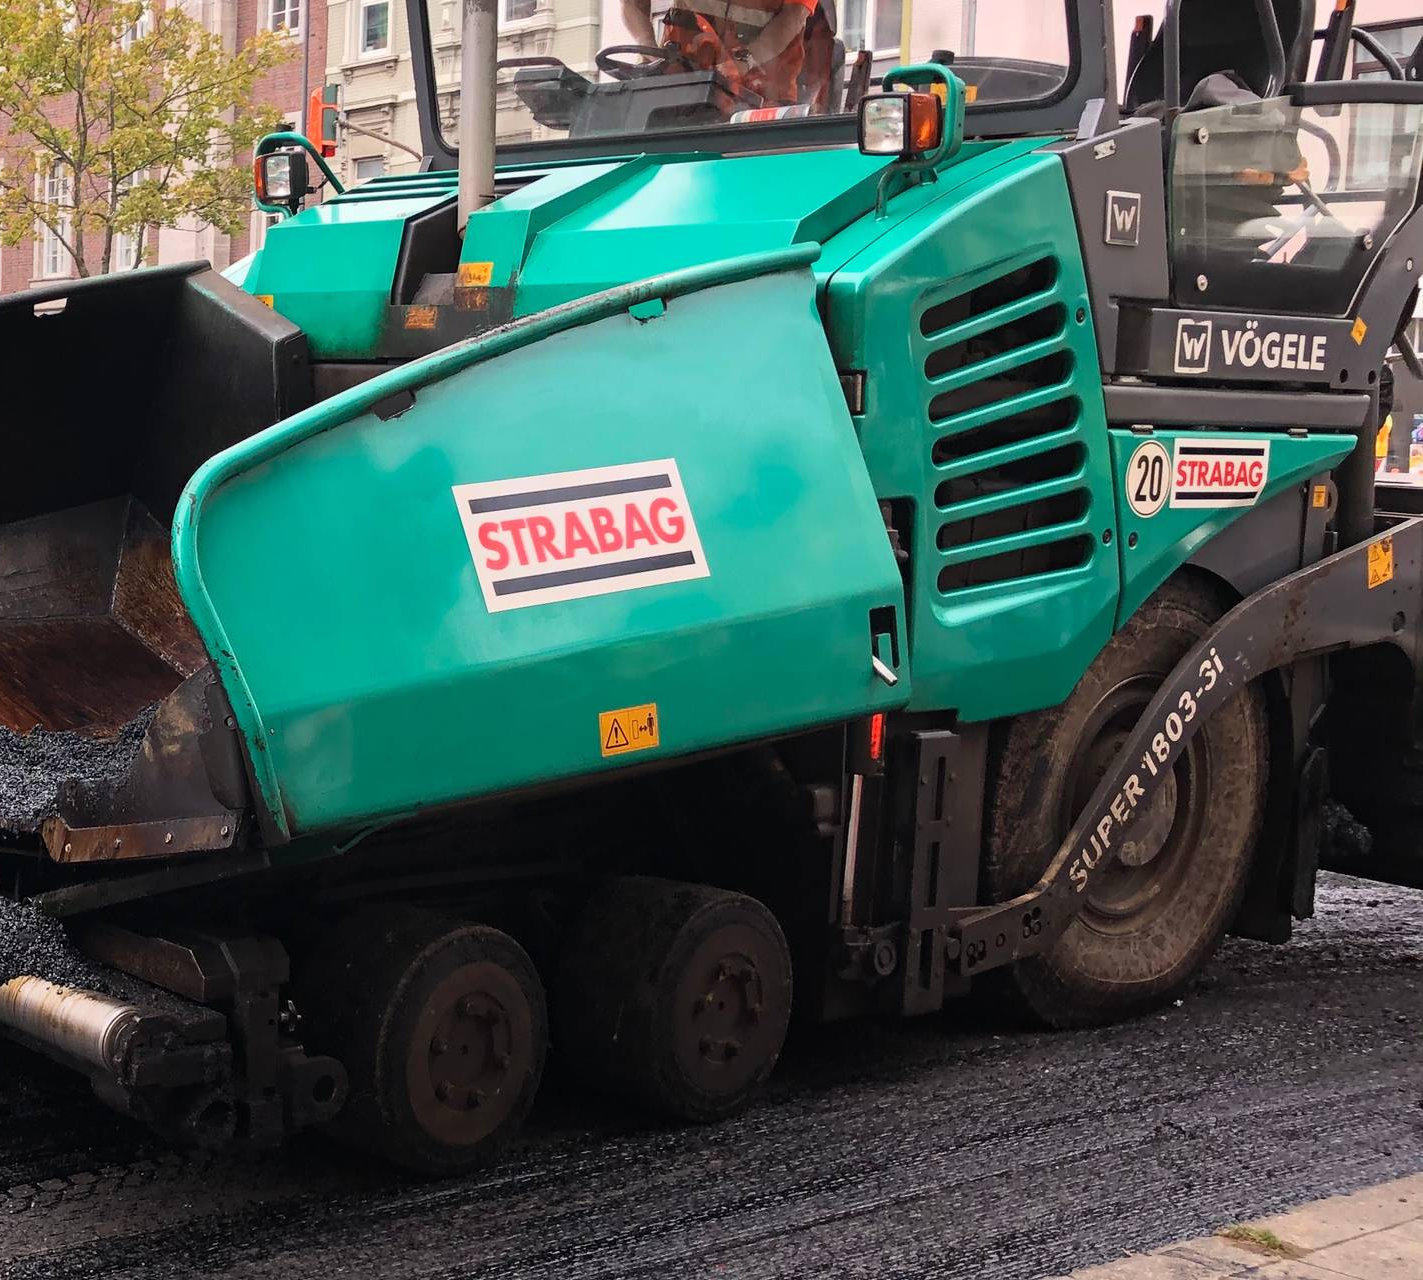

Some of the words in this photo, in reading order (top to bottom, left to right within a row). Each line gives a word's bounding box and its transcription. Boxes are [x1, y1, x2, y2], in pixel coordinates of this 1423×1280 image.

[1222, 320, 1327, 371] VÖGELE
[1135, 455, 1164, 502] 20
[1176, 460, 1264, 487] STRABAG
[478, 497, 686, 571] STRABAG
[1069, 773, 1146, 893] SUPER
[1140, 647, 1225, 777] 1803-3i
